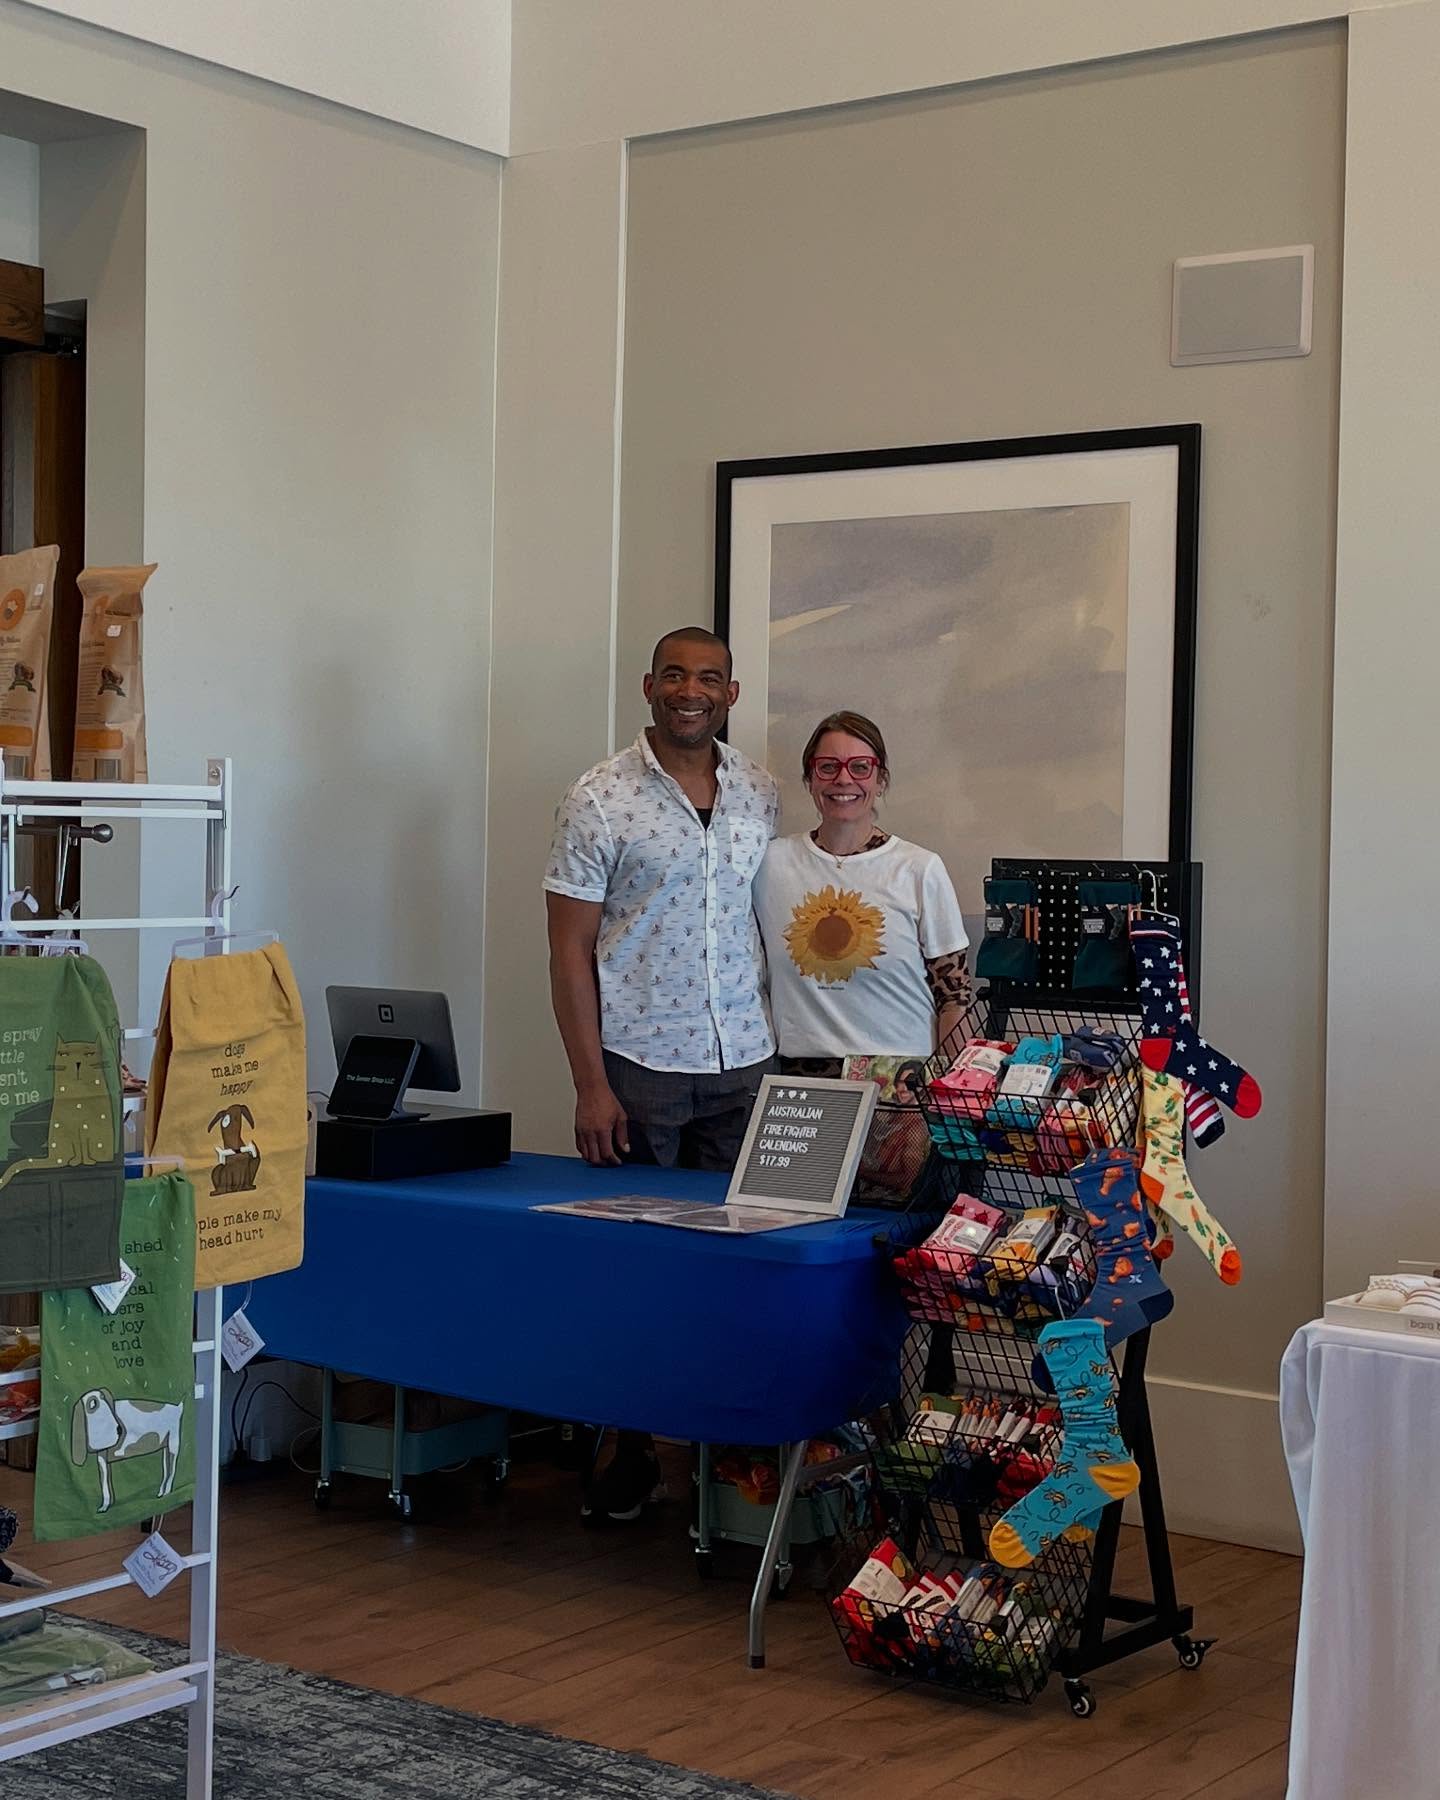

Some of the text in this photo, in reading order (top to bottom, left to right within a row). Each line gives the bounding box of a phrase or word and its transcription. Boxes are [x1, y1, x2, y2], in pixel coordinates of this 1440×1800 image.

[3, 1026, 43, 1045] spray
[211, 1060, 259, 1078] make me
[220, 1080, 254, 1096] happy
[15, 1090, 40, 1106] me
[767, 1106, 824, 1119] AUSTRALIAN
[759, 1138, 809, 1153] CALENDARS
[759, 1154, 791, 1168] $17.99
[223, 1210, 260, 1227] make
[262, 1208, 282, 1222] my
[124, 1238, 164, 1254] shed
[199, 1227, 265, 1251] head hurt
[101, 1319, 145, 1336] of joy
[111, 1336, 143, 1351] and
[113, 1355, 145, 1369] love
